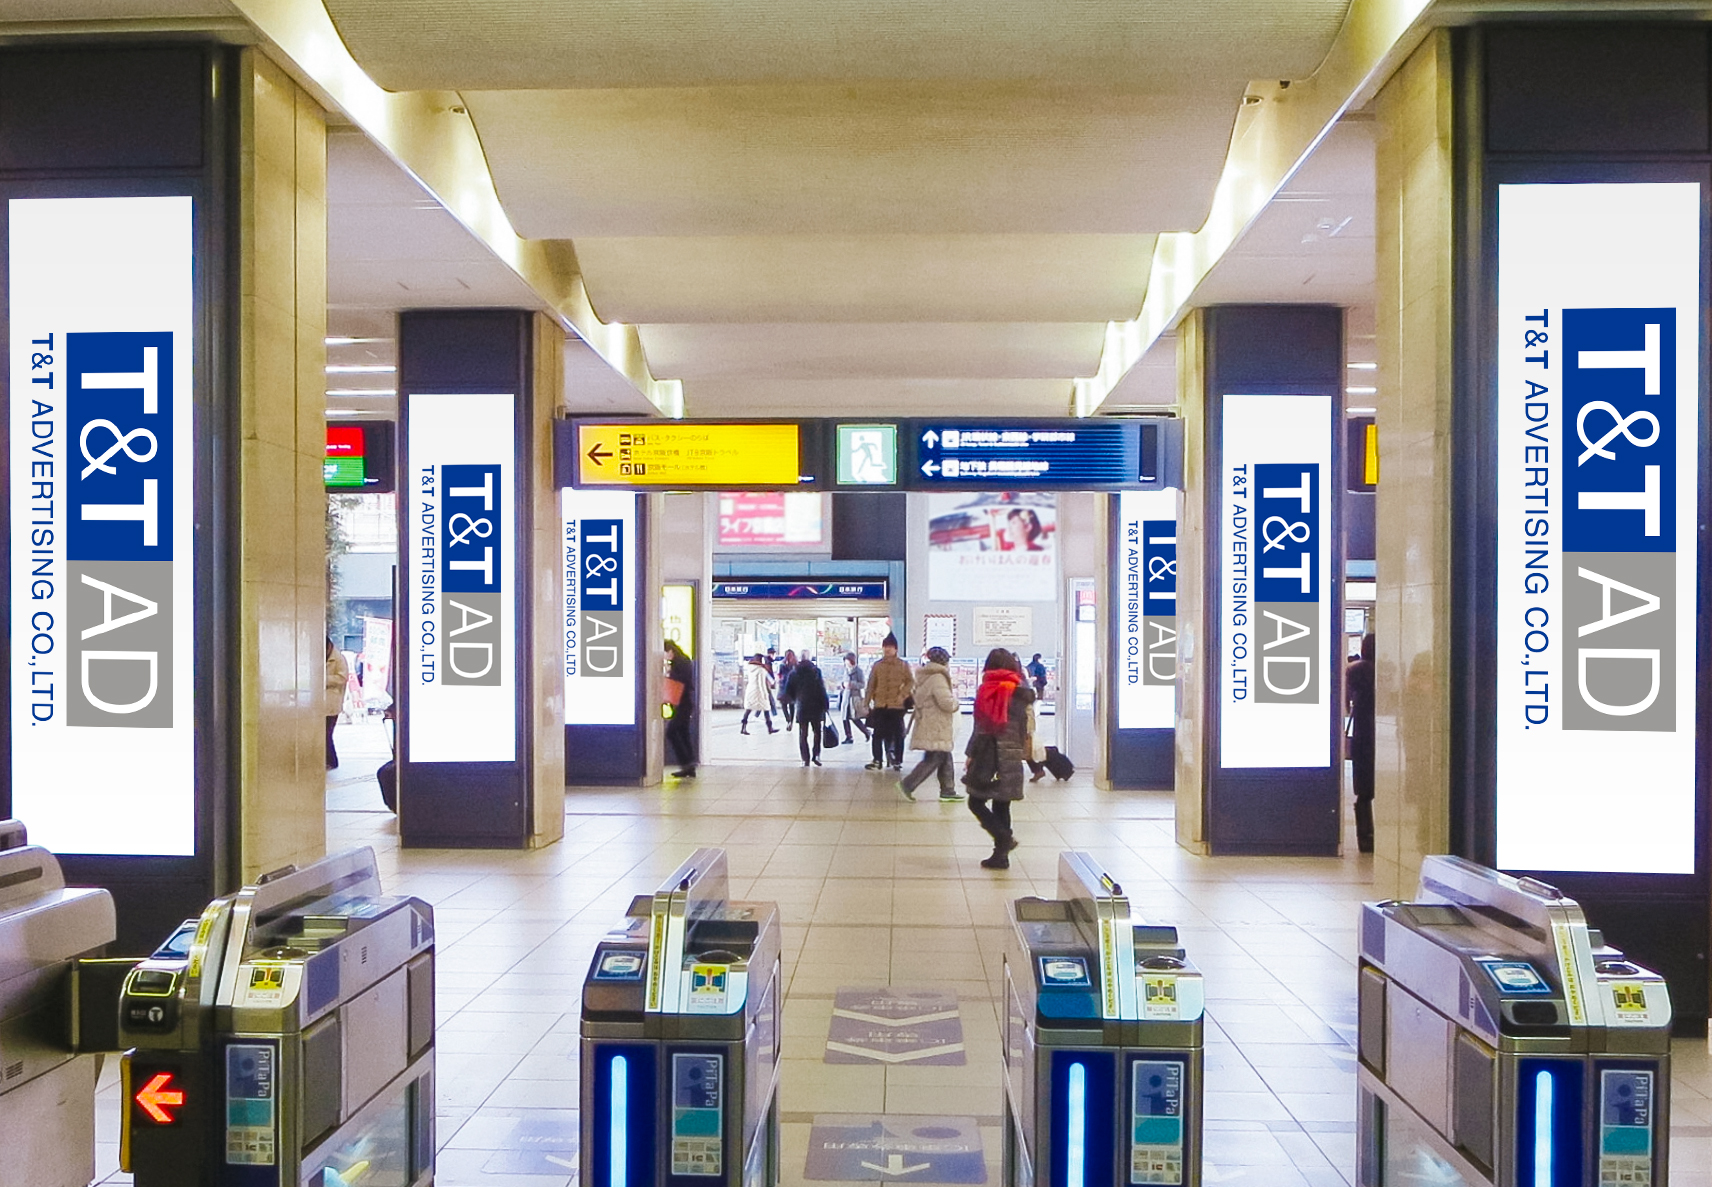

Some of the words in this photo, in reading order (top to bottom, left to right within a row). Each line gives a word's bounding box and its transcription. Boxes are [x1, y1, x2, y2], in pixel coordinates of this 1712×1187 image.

[31, 332, 54, 390] T&T
[1524, 308, 1549, 370] T&T
[79, 346, 159, 546] T&T
[1576, 323, 1661, 537] T&T
[31, 399, 55, 600] ADVERTISING
[421, 464, 435, 498] T&T
[1232, 463, 1247, 499] T&T
[1524, 379, 1550, 595] ADVERTISING
[421, 502, 435, 615] ADVERTISING
[448, 472, 493, 585] T&T
[566, 519, 576, 543] T&T
[585, 525, 618, 605] T&T
[1127, 520, 1139, 545] T&T
[1232, 503, 1248, 627] ADVERTISING
[1262, 472, 1311, 594] T&T
[565, 545, 577, 627] ADVERTISING
[1127, 548, 1139, 633] ADVERTISING
[28, 611, 55, 727] CO.,LTD.
[79, 573, 159, 715] AD
[420, 620, 435, 686] CO.,LTD.
[449, 599, 493, 679] AD
[585, 615, 618, 673] AD
[1231, 632, 1248, 703] CO.,LTD.
[1262, 609, 1311, 696] AD
[1521, 606, 1550, 730] CO.,LTD.
[1576, 566, 1661, 717] AD
[257, 1049, 271, 1097] PiTaPa
[705, 1059, 718, 1107] PiTaPa
[1165, 1066, 1179, 1115] PiTaPa
[1634, 1075, 1648, 1124] PiTaPa
